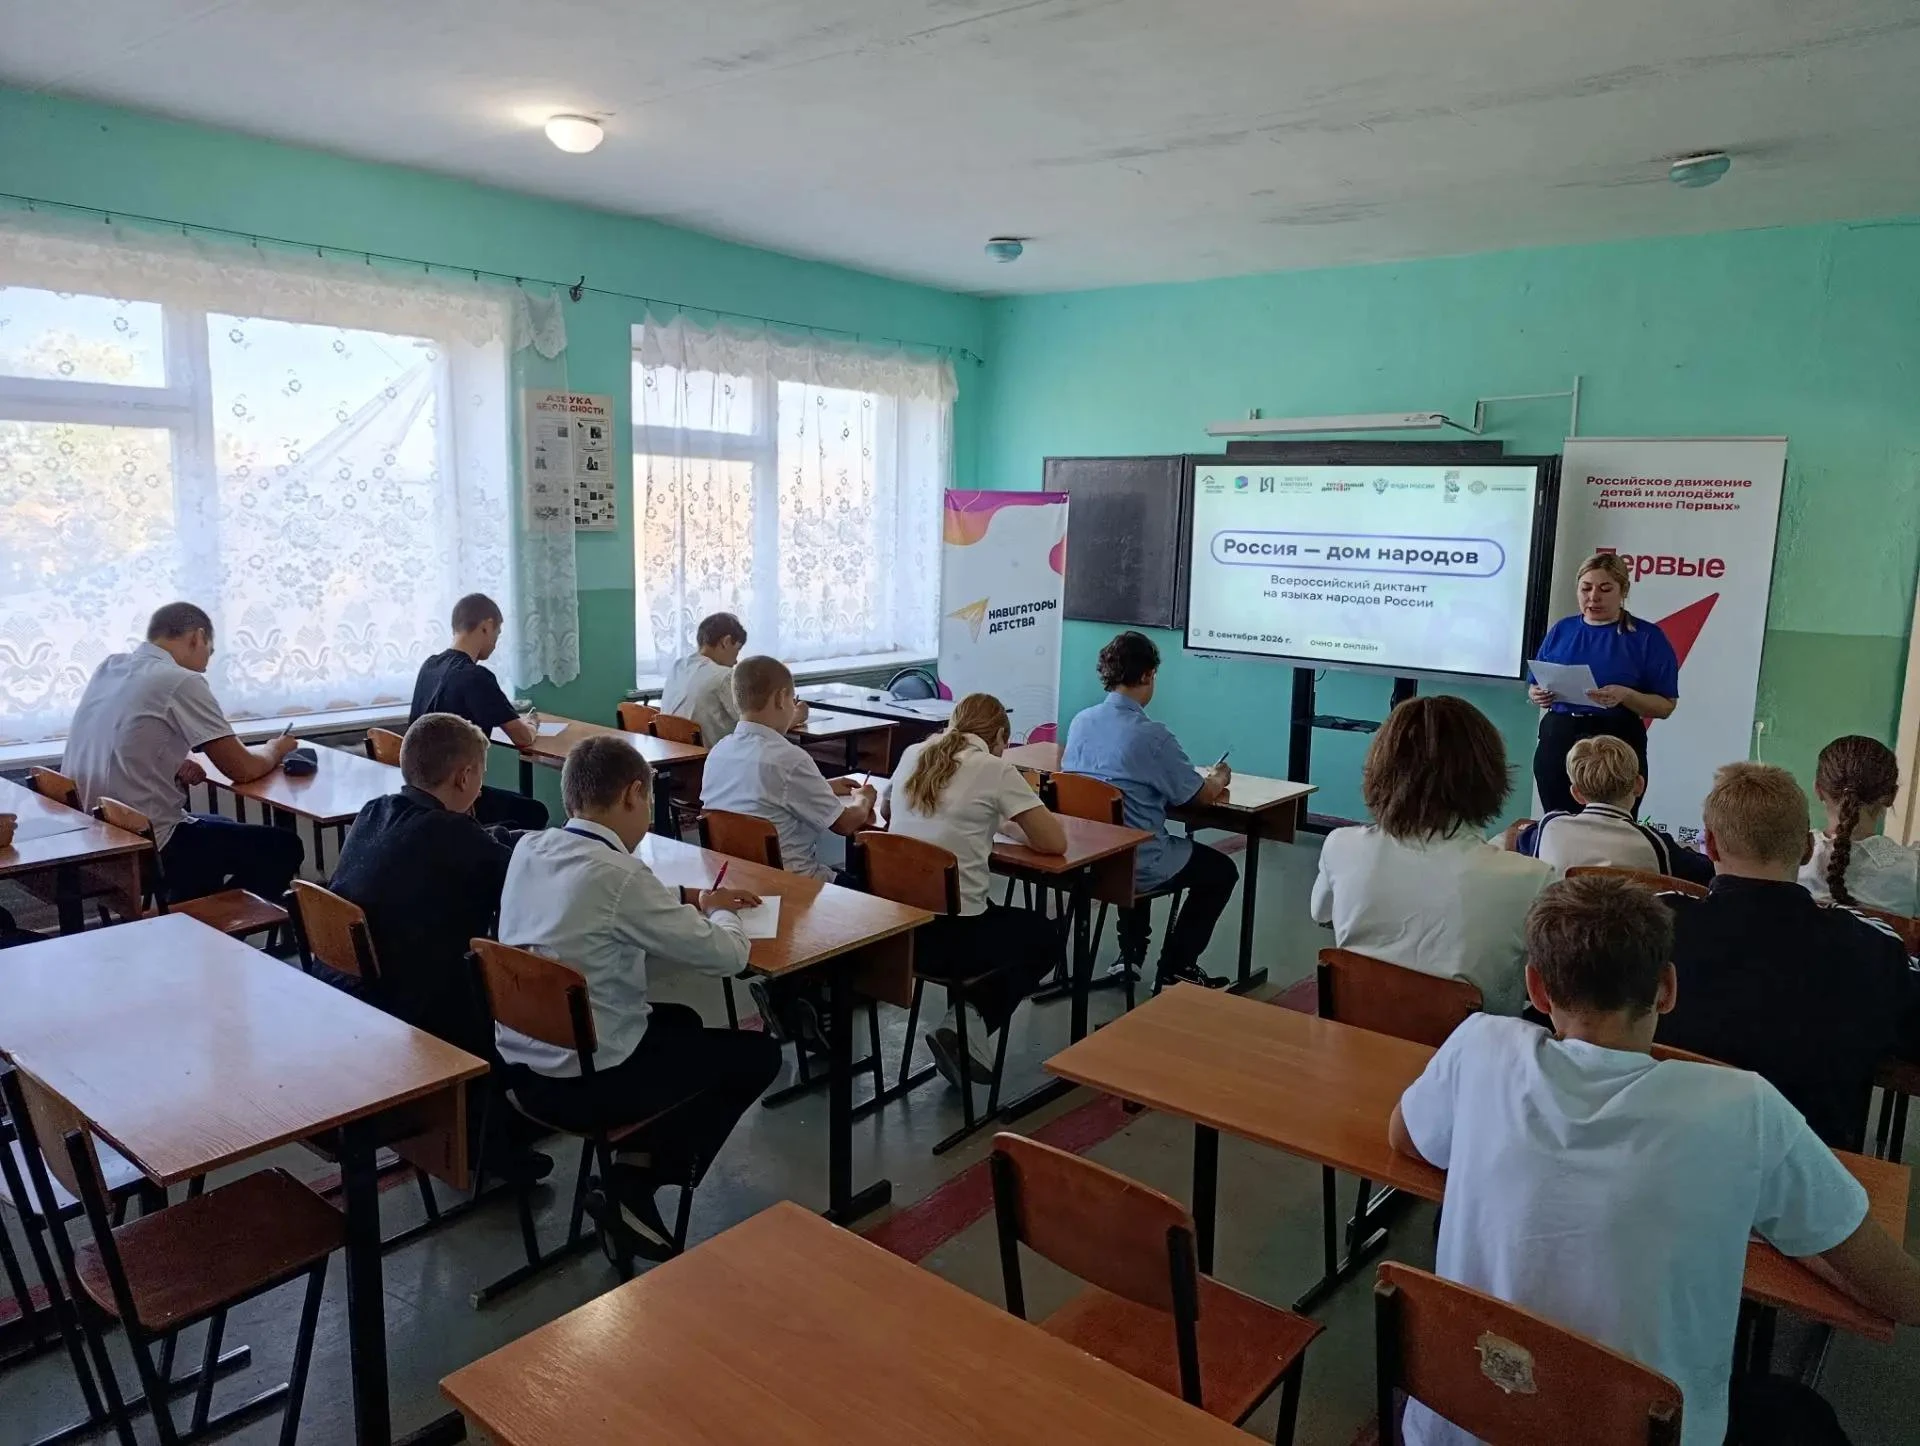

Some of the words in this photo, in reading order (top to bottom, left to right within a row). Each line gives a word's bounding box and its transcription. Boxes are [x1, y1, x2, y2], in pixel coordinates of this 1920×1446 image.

[1586, 476, 1672, 487] Российское
[1674, 478, 1752, 488] движение
[1600, 488, 1642, 498] детей
[1644, 489, 1654, 497] и
[1656, 488, 1735, 499] молодёжи
[1592, 499, 1673, 510] «Движение
[1675, 500, 1740, 511] Первых»
[1223, 538, 1298, 556] Россия
[1326, 546, 1370, 561] дом
[1377, 546, 1479, 566] народов
[1270, 574, 1370, 590] Всероссийский
[1373, 581, 1427, 593] диктант
[1263, 589, 1278, 598] на
[1280, 590, 1323, 601] языках
[1326, 593, 1381, 606] народов
[1384, 595, 1434, 608] России
[988, 599, 1057, 620] НАВИГАТОРЫ
[989, 616, 1036, 635] ДЕТСТВА
[1208, 629, 1215, 638] 8
[1216, 631, 1258, 642] сентября
[1259, 634, 1284, 644] 2026
[1342, 642, 1379, 651] онлайн
